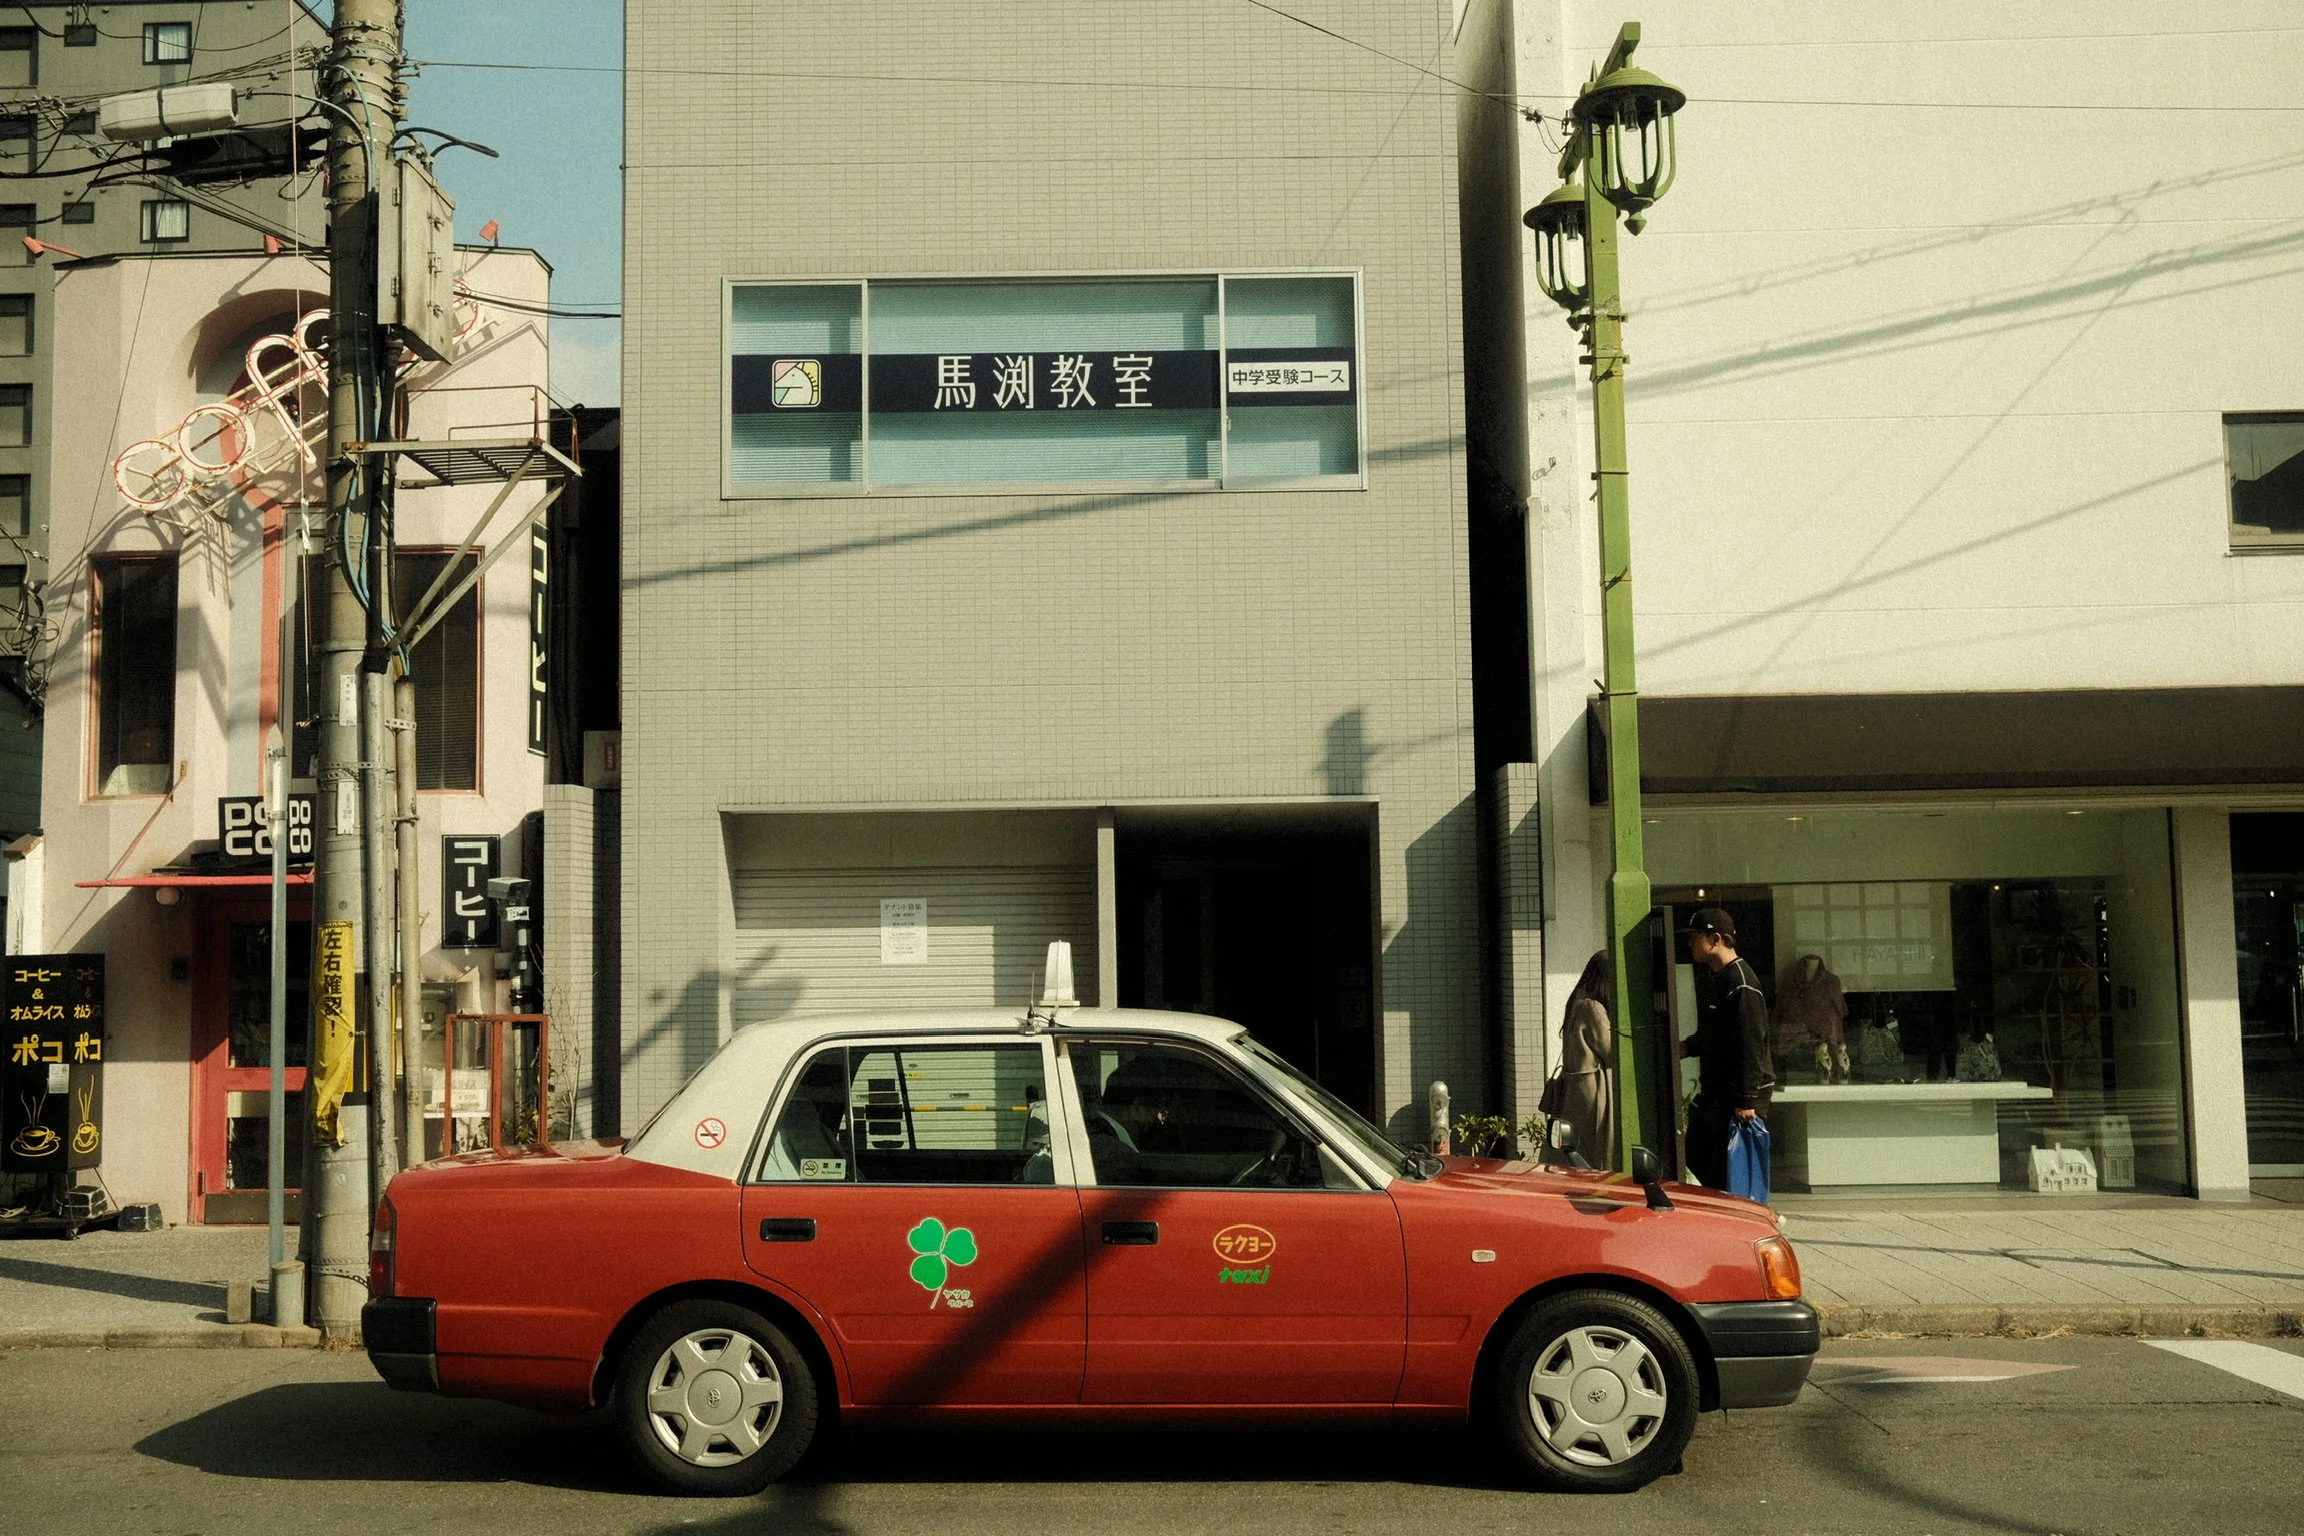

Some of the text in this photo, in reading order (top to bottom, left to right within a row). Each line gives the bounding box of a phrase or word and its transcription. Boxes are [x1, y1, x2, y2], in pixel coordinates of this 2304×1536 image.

[934, 353, 1154, 410] 馬渕教室
[1232, 368, 1345, 386] 中学受験コース
[532, 535, 548, 742] コーヒー
[453, 841, 488, 941] コーヒー
[14, 968, 62, 983] コーヒー
[31, 988, 45, 1000] &
[10, 1005, 65, 1021] オムライス
[11, 1034, 63, 1066] ポコ
[74, 1032, 102, 1064] ポコ
[1219, 1235, 1272, 1254] ラクヨー
[1218, 1265, 1271, 1284] taxi
